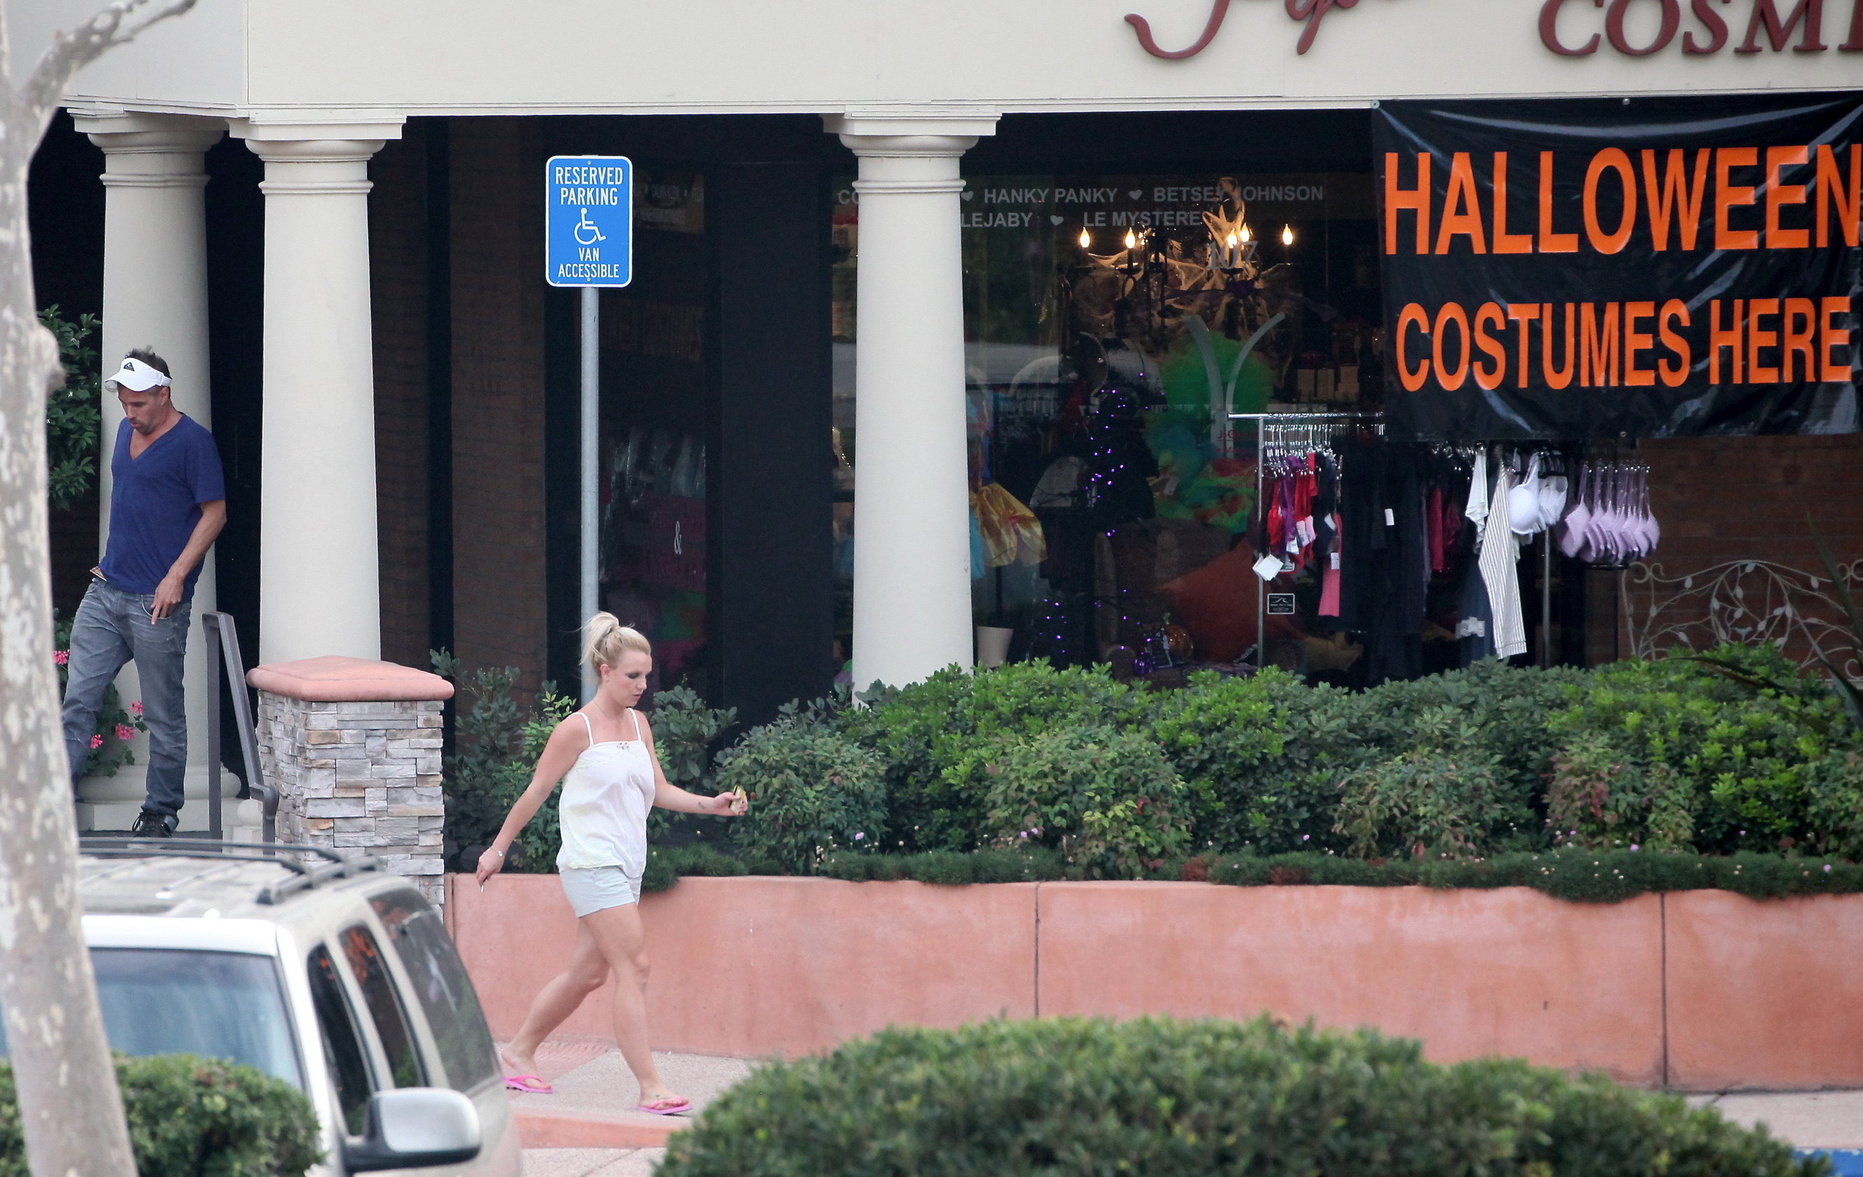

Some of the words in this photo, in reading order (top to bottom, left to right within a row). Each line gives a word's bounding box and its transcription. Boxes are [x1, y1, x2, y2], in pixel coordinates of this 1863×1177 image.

[555, 166, 623, 185] RESERVED
[560, 187, 619, 206] PARKING
[984, 188, 1049, 204] HANKY
[1055, 188, 1118, 203] PANKY
[1153, 186, 1226, 203] BETSEY
[1384, 143, 1863, 256] HALLOWEEN
[961, 212, 1033, 228] LEJABY
[1083, 212, 1106, 227] LE
[1112, 210, 1201, 227] MYSTERE
[578, 247, 600, 262] VAN
[558, 263, 620, 278] ACCESSIBLE
[1396, 299, 1692, 392] COSTUMES
[1709, 296, 1852, 385] HERE
